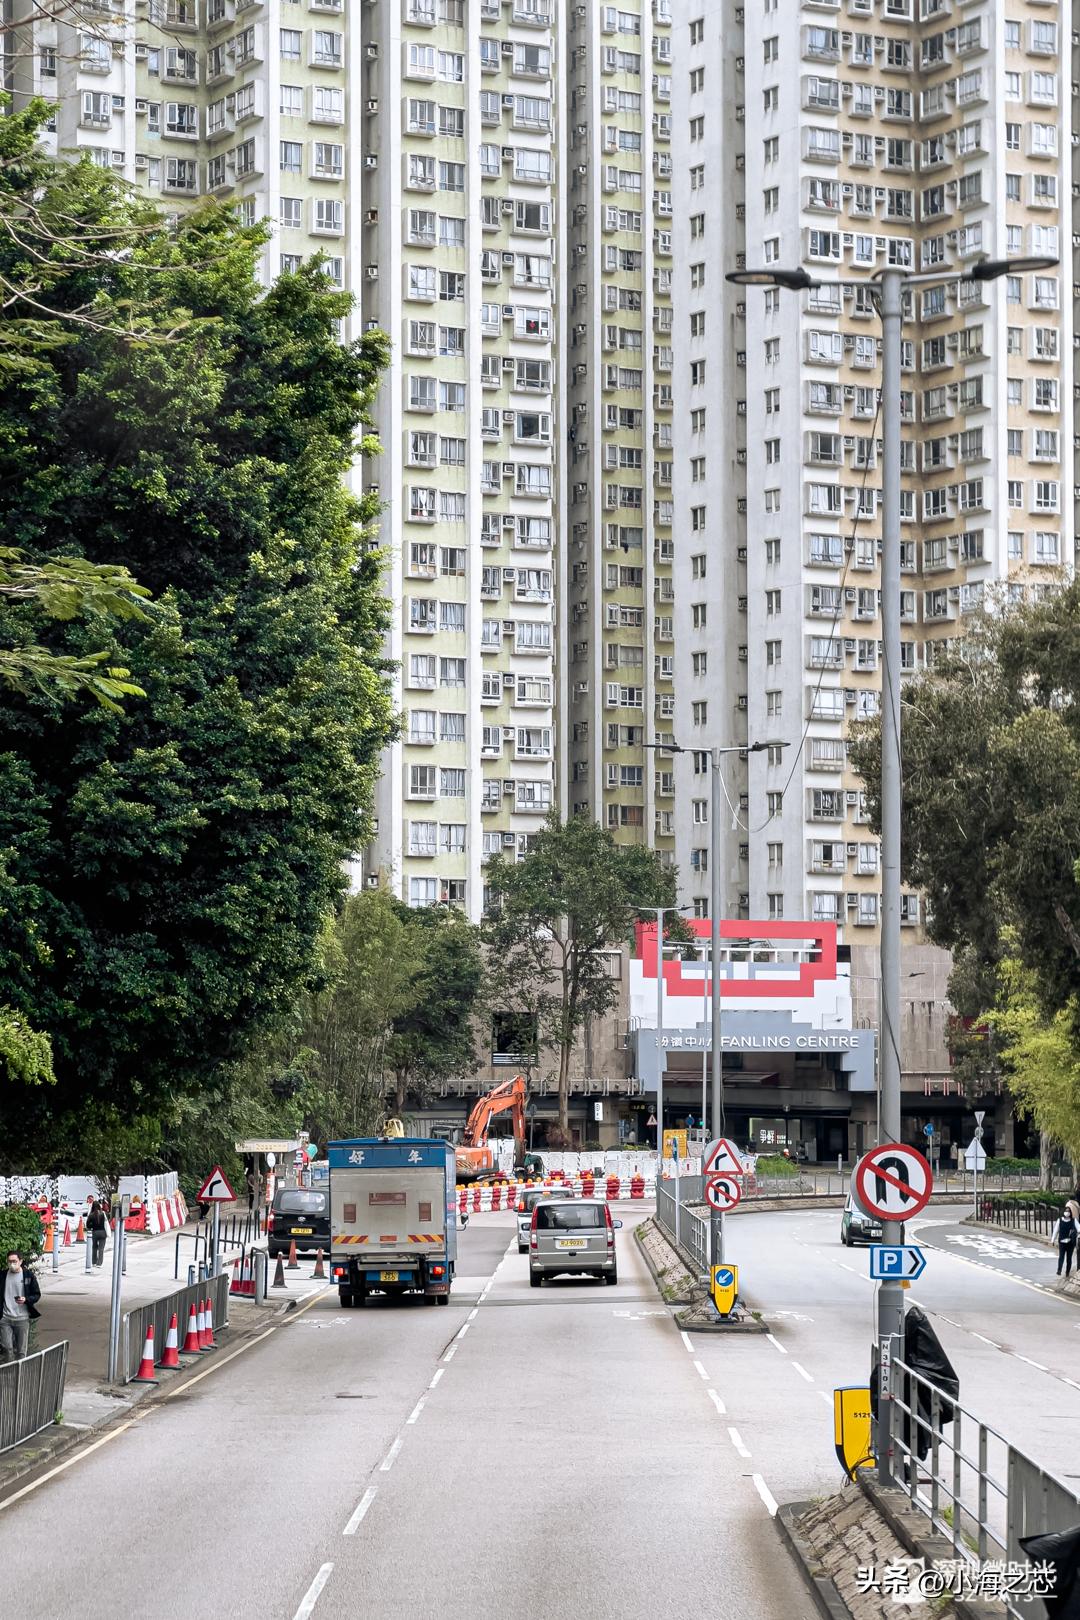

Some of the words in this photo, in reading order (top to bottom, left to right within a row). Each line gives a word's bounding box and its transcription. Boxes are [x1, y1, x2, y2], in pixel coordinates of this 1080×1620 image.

[720, 1036, 791, 1048] FANLING
[796, 1036, 860, 1048] CENTRE
[349, 1150, 365, 1165] 好
[408, 1149, 422, 1163] 年
[884, 1252, 898, 1271] P
